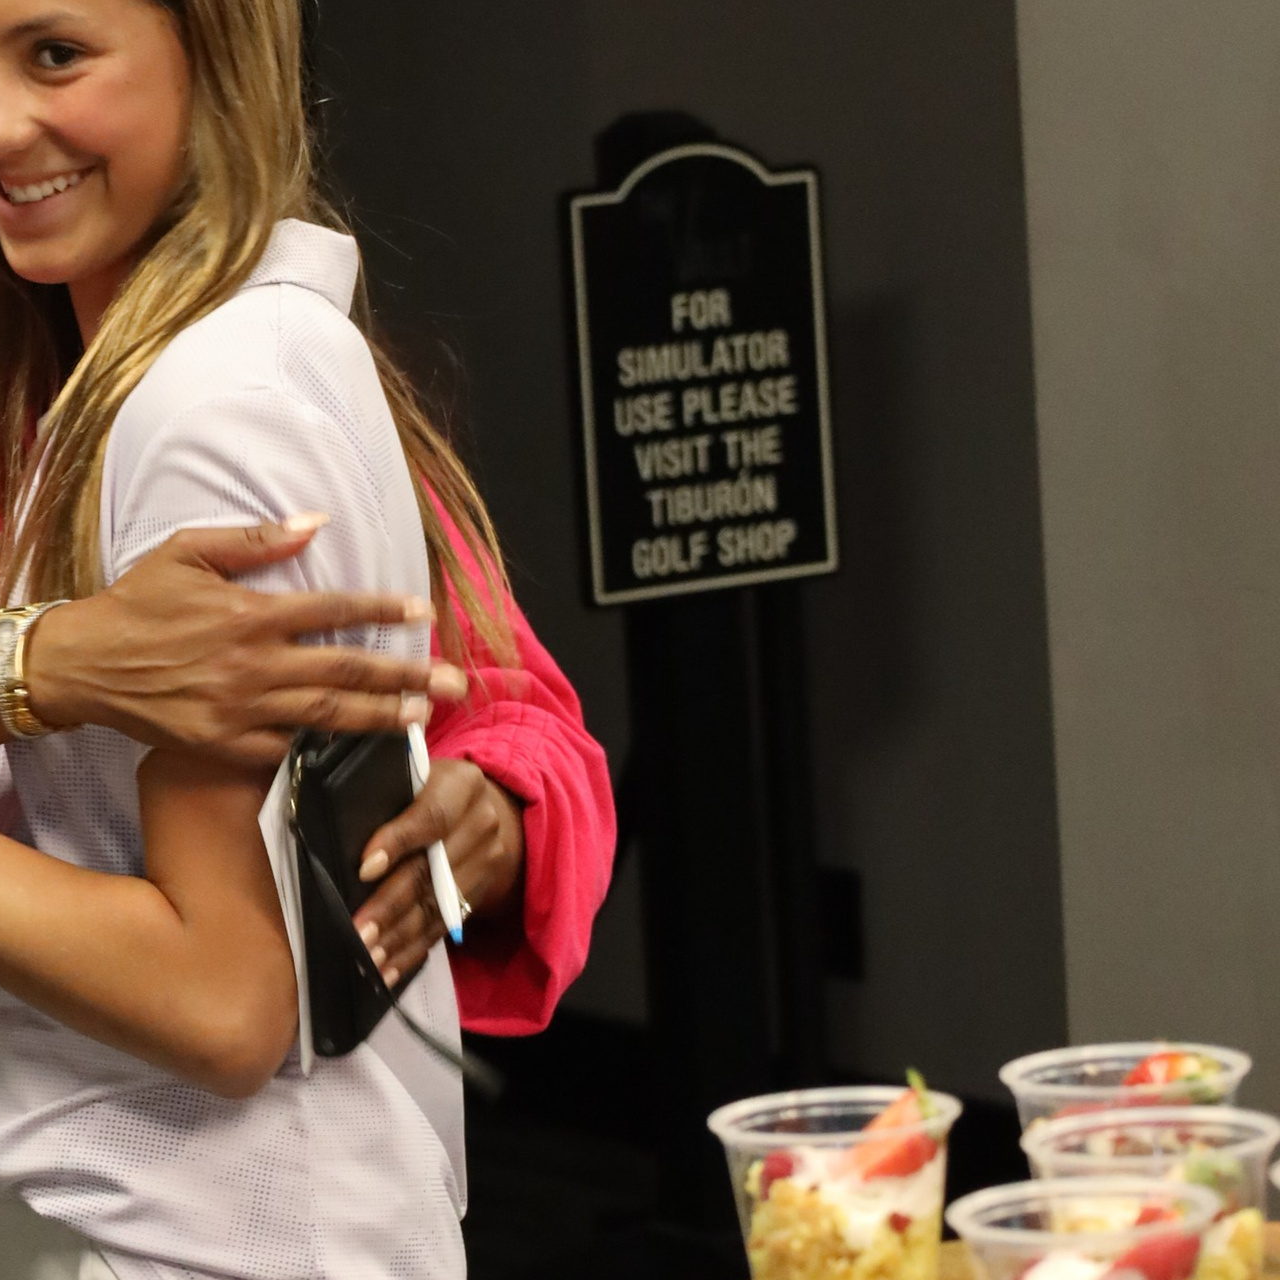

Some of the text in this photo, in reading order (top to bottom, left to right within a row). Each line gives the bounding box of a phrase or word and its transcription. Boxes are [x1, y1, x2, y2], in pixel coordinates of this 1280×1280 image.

[671, 288, 731, 332] FOR
[617, 329, 789, 388] SIMULATOR
[614, 375, 798, 436] USE PLEASE
[634, 425, 782, 481] VISIT THE
[646, 469, 777, 528] TIBURÓN
[632, 520, 798, 578] GOLF SHOP
